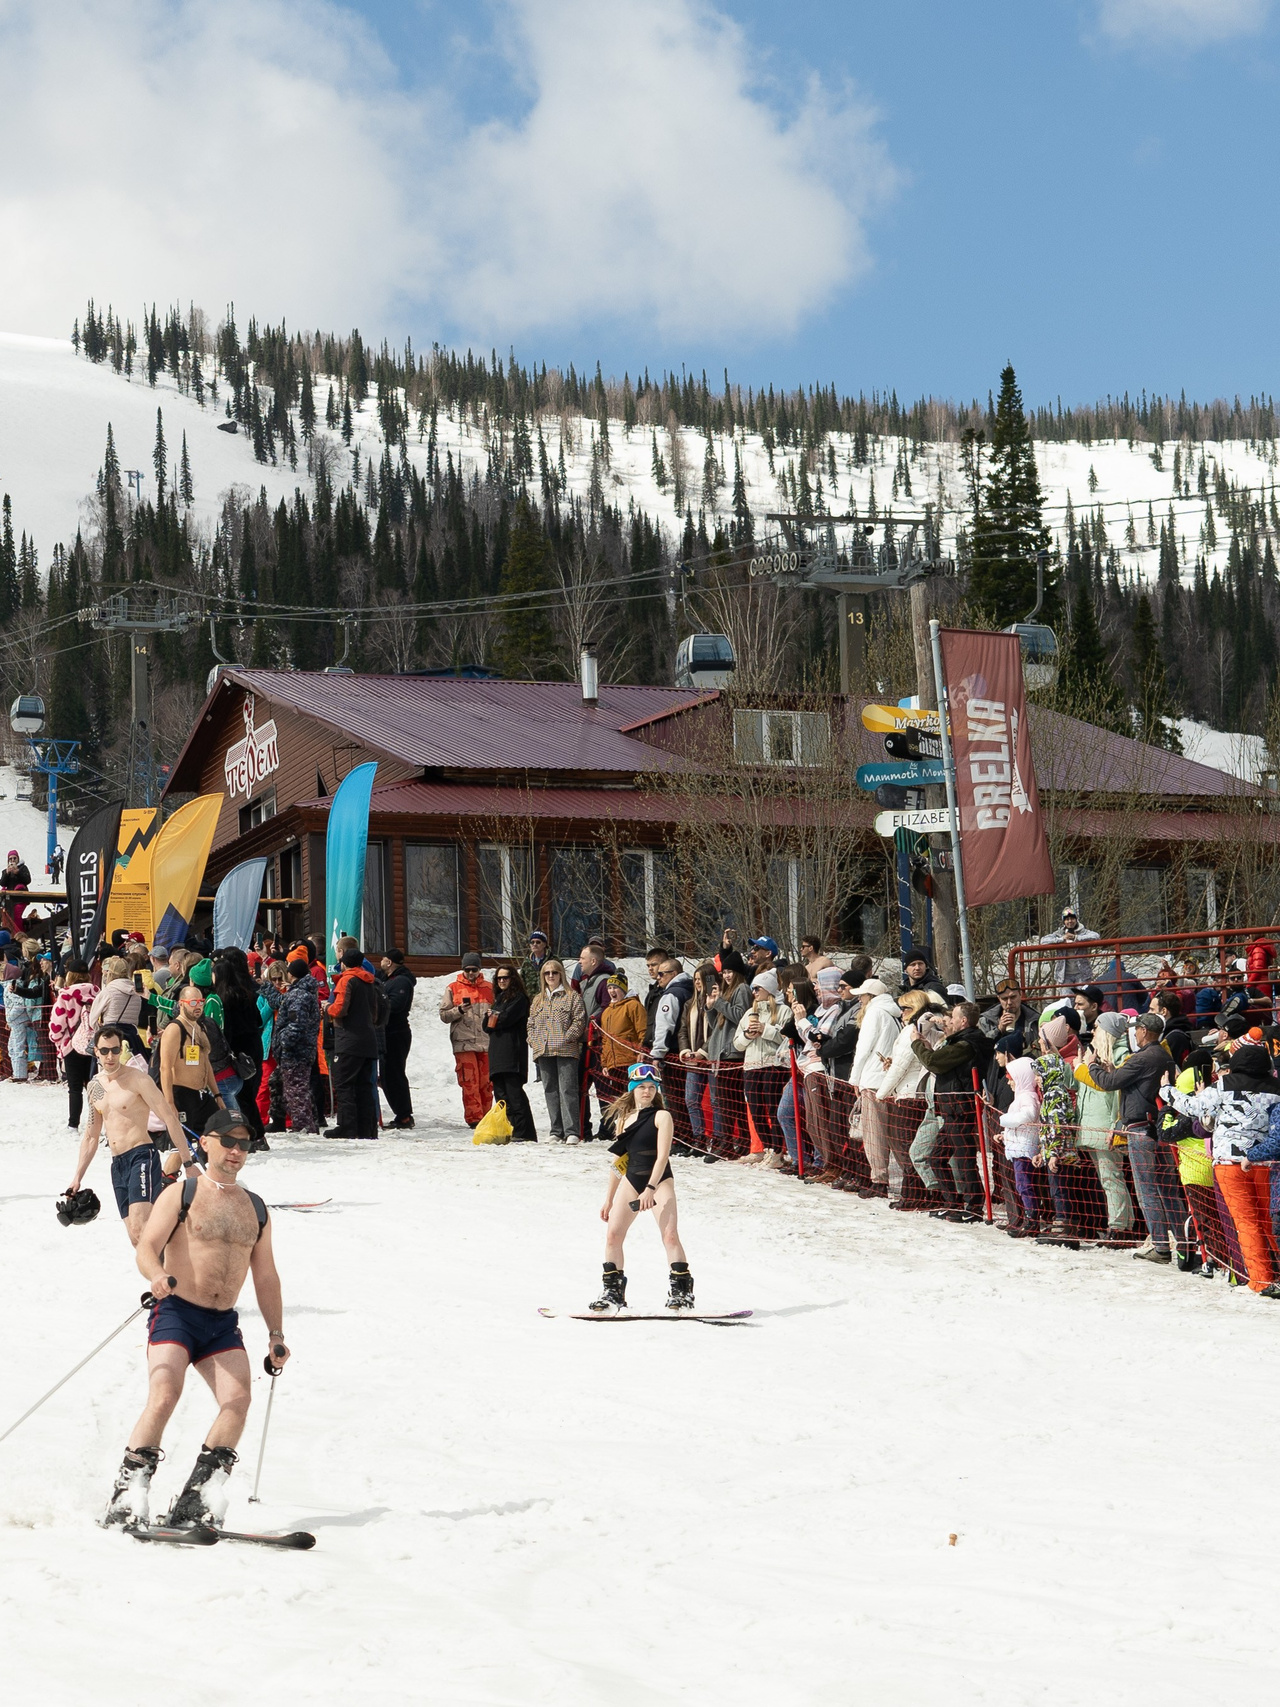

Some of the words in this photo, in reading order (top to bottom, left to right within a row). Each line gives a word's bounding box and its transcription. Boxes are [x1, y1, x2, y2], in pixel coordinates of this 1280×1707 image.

[848, 612, 864, 624] 13
[135, 646, 147, 654] 14
[966, 698, 1012, 830] GRELKA
[864, 770, 918, 783] Mammoth
